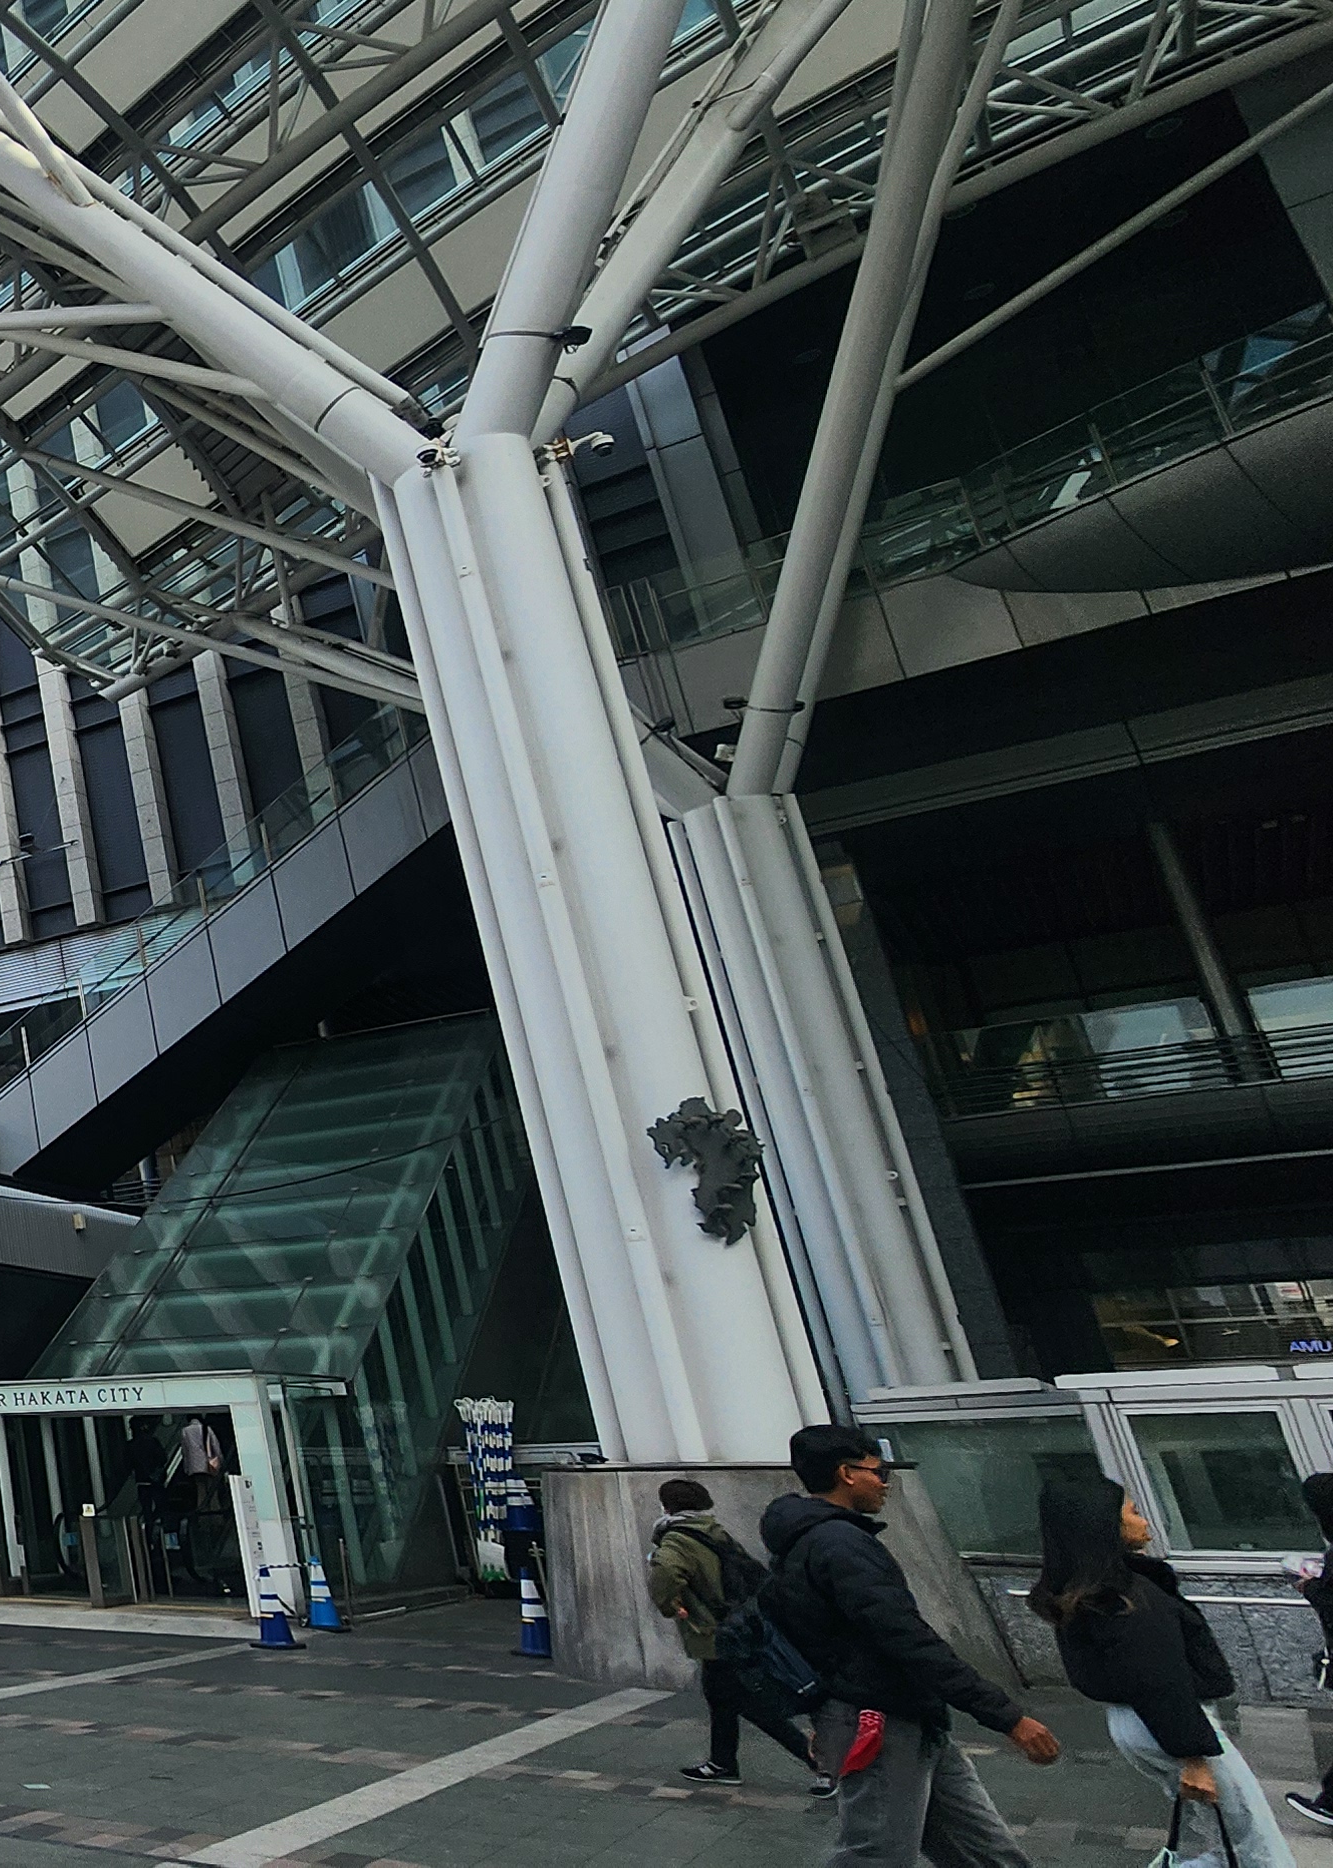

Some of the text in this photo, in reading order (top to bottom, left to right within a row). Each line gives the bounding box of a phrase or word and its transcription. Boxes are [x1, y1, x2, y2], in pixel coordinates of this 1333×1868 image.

[1289, 1340, 1333, 1353] AMU
[13, 1389, 90, 1407] HAKATA
[97, 1386, 144, 1403] CITY
